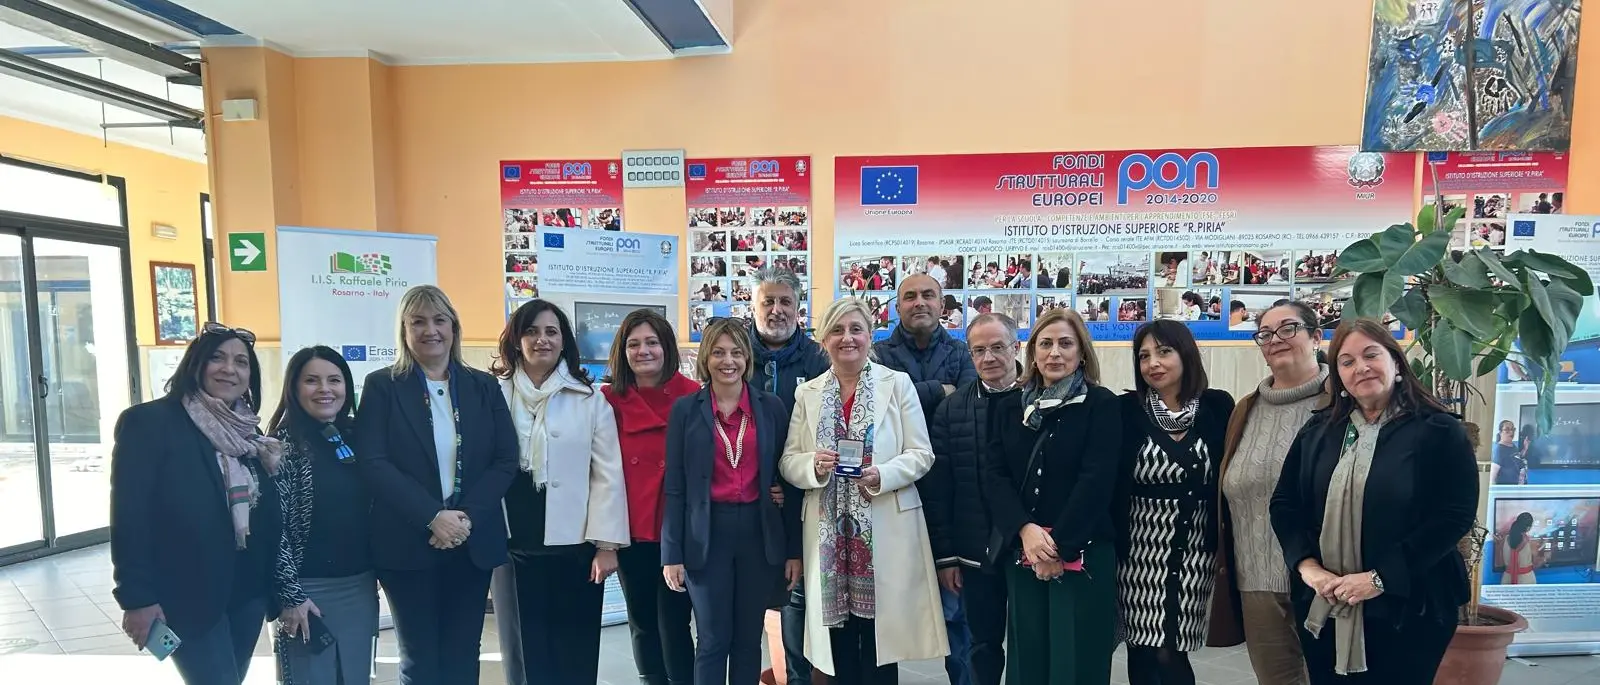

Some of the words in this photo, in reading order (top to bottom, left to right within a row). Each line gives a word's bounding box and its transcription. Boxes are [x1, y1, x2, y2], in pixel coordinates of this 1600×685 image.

[750, 160, 780, 178] pon
[1053, 154, 1104, 170] FONDI
[995, 174, 1104, 190] STRUTTURALI
[1116, 152, 1220, 206] pon
[1032, 192, 1104, 206] EUROPEI
[1146, 193, 1218, 205] 2014-2020
[1004, 224, 1048, 237] ISTITUTO
[1051, 223, 1121, 235] D'ISTRUZIONE
[1125, 222, 1180, 234] SUPERIORE
[1183, 221, 1226, 233] "R.PIRIA"
[616, 238, 640, 252] pon
[311, 275, 335, 285] I.I.S.
[340, 276, 381, 286] Raffaele
[386, 278, 408, 287] Piria
[332, 288, 364, 297] Rosarno
[373, 290, 390, 298] Italy
